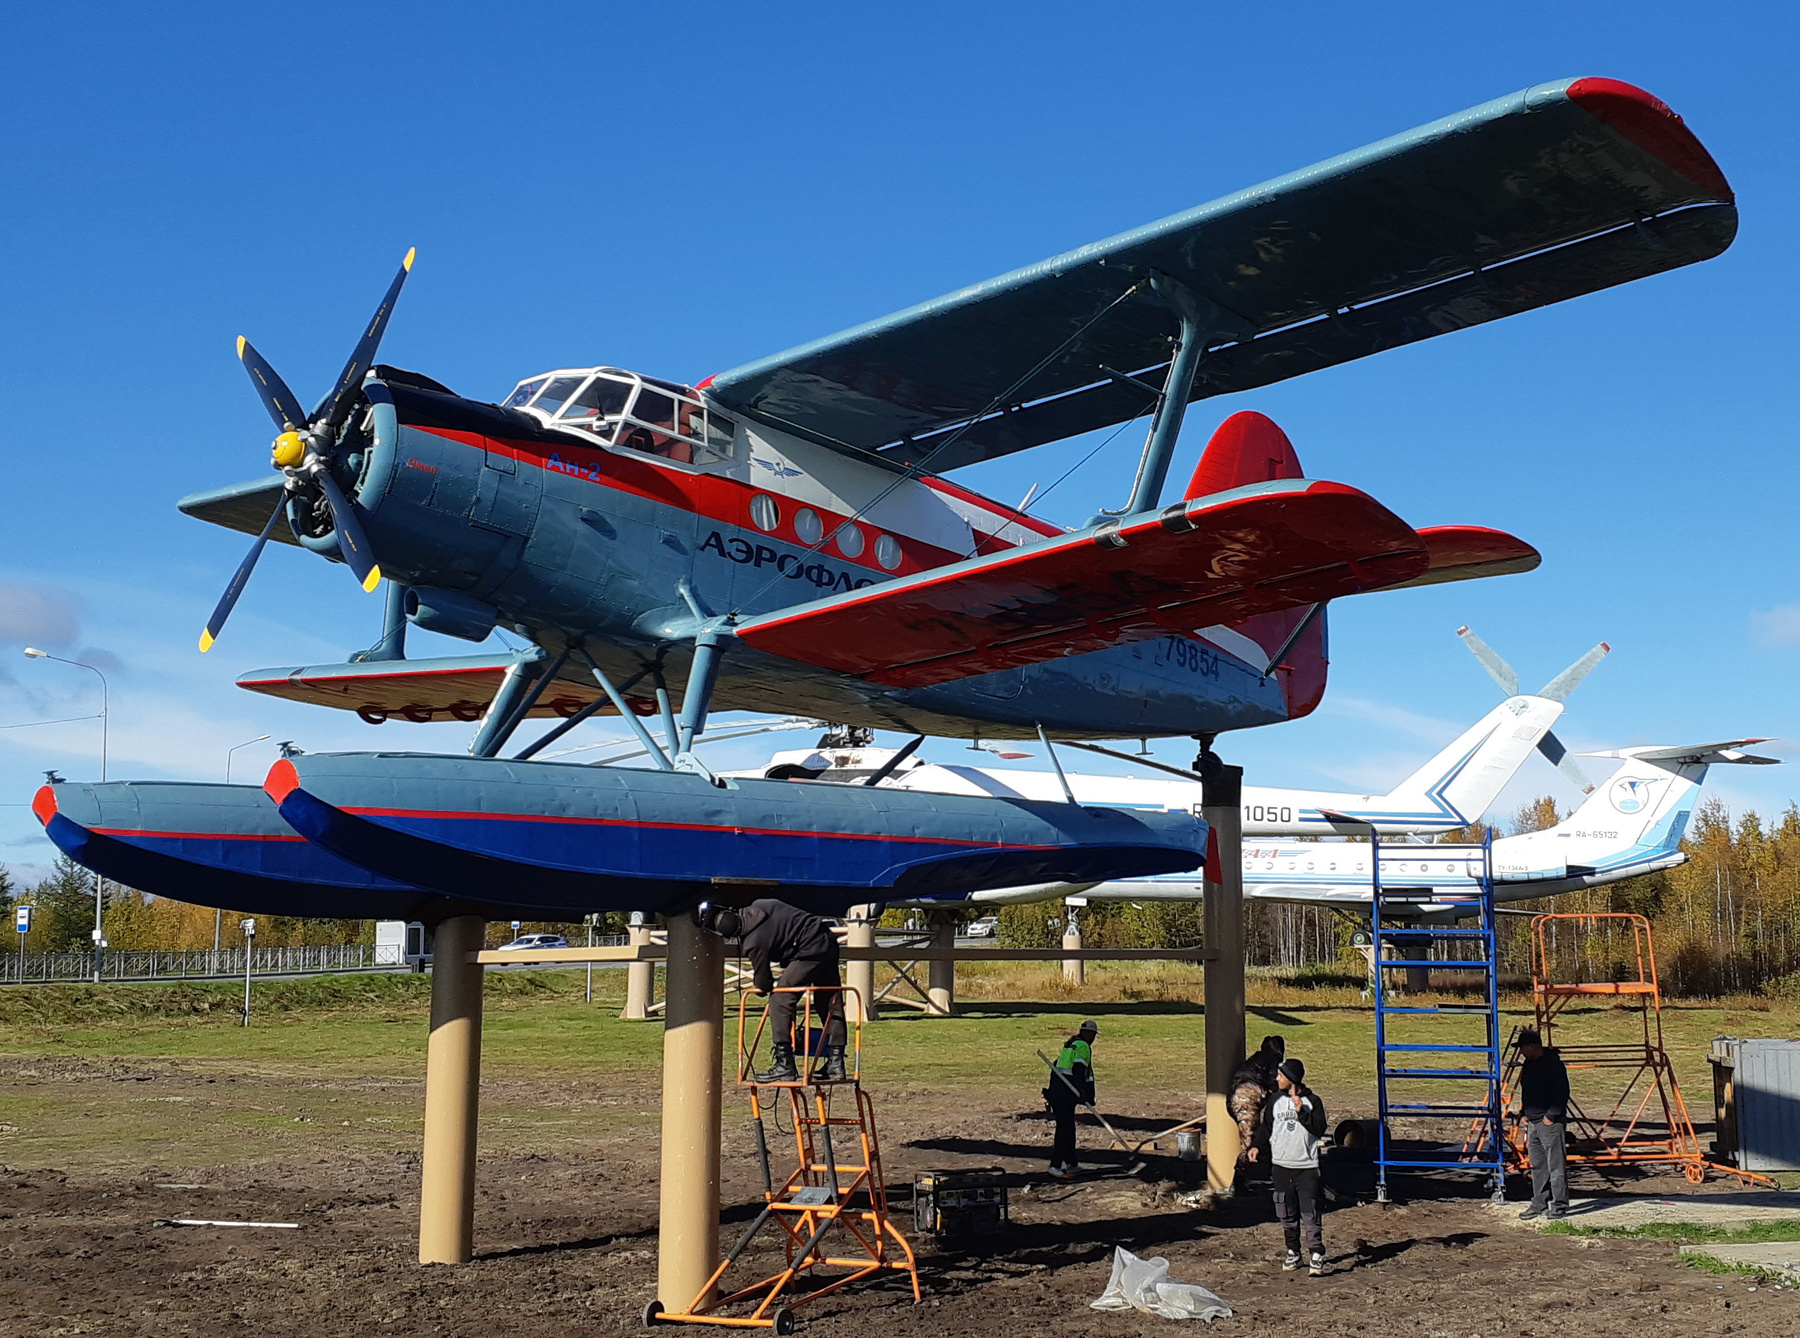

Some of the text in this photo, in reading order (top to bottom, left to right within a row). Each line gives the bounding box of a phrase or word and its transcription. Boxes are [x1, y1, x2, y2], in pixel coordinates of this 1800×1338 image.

[547, 452, 600, 481] Ан-2
[1165, 634, 1220, 682] 79854
[1576, 830, 1618, 839] RA-65132
